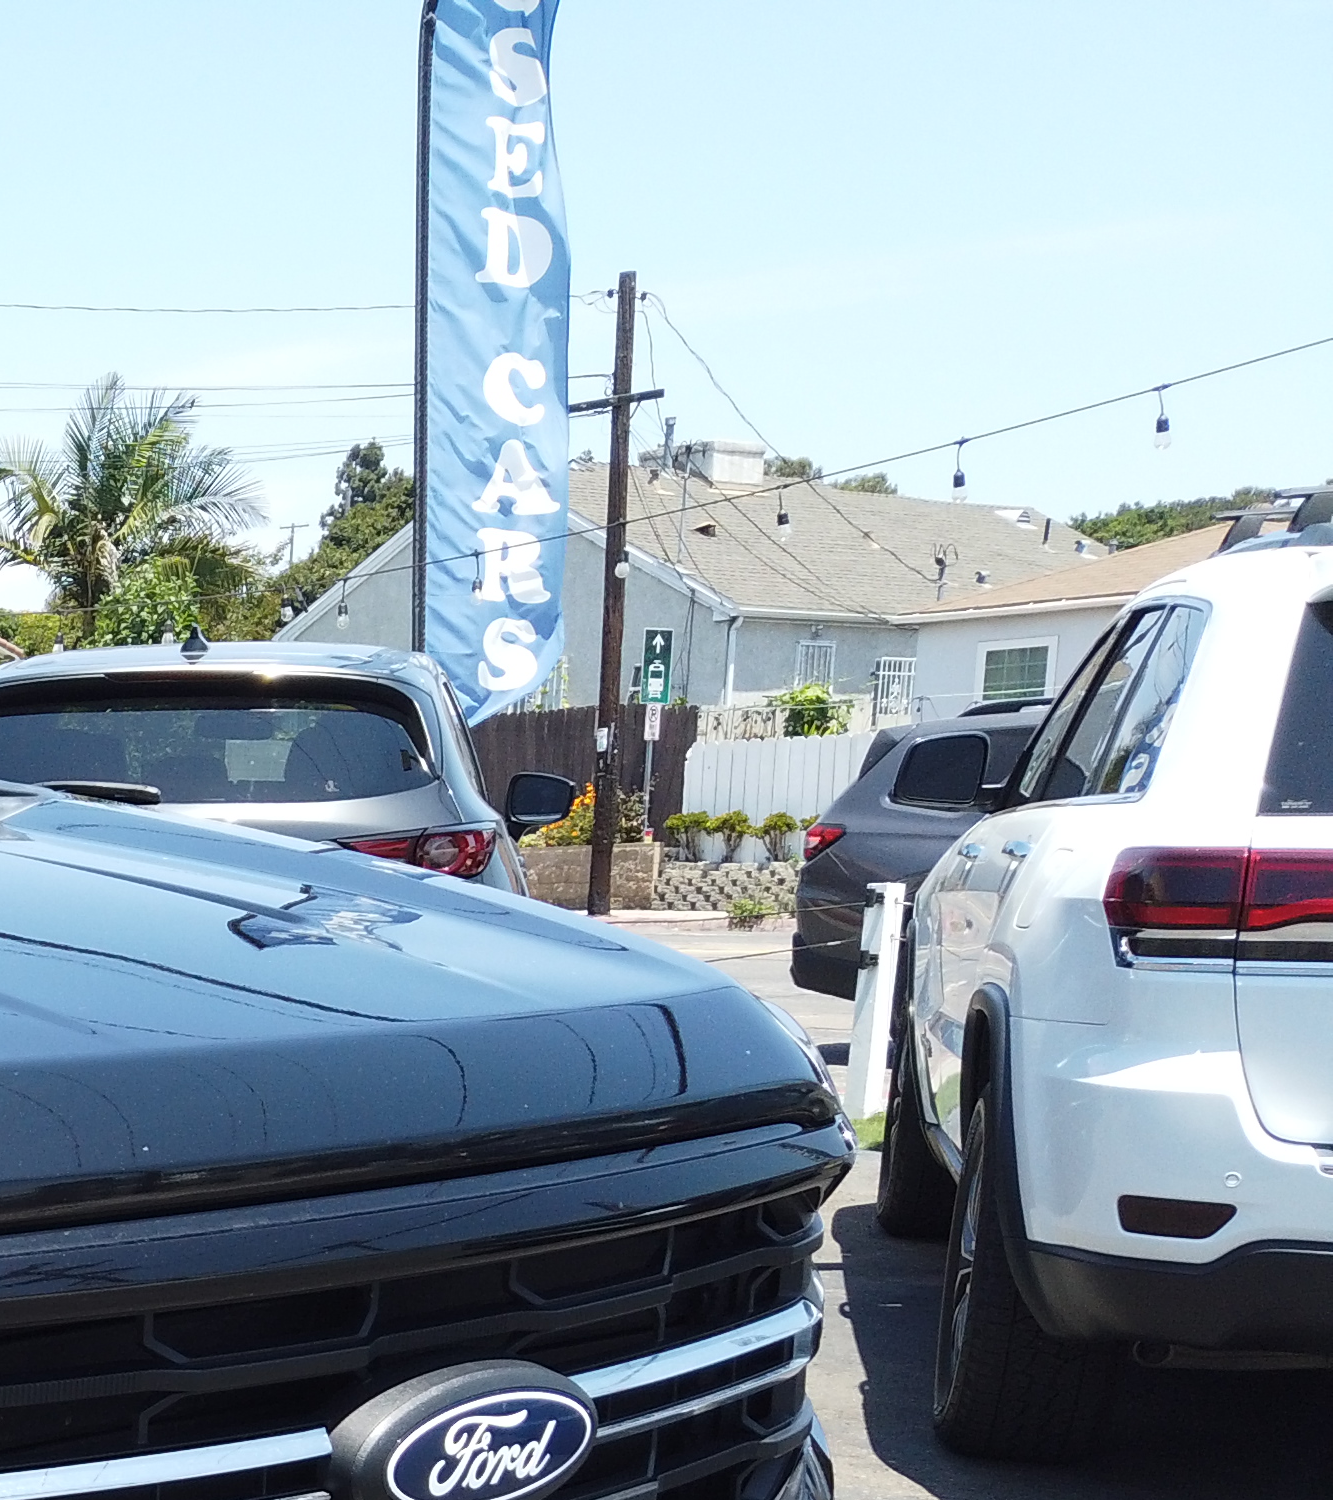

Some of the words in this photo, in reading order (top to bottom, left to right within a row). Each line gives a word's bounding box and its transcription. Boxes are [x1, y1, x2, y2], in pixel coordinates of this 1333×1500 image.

[474, 0, 554, 289] SED
[471, 351, 561, 693] CARS
[428, 1409, 557, 1497] Ford
